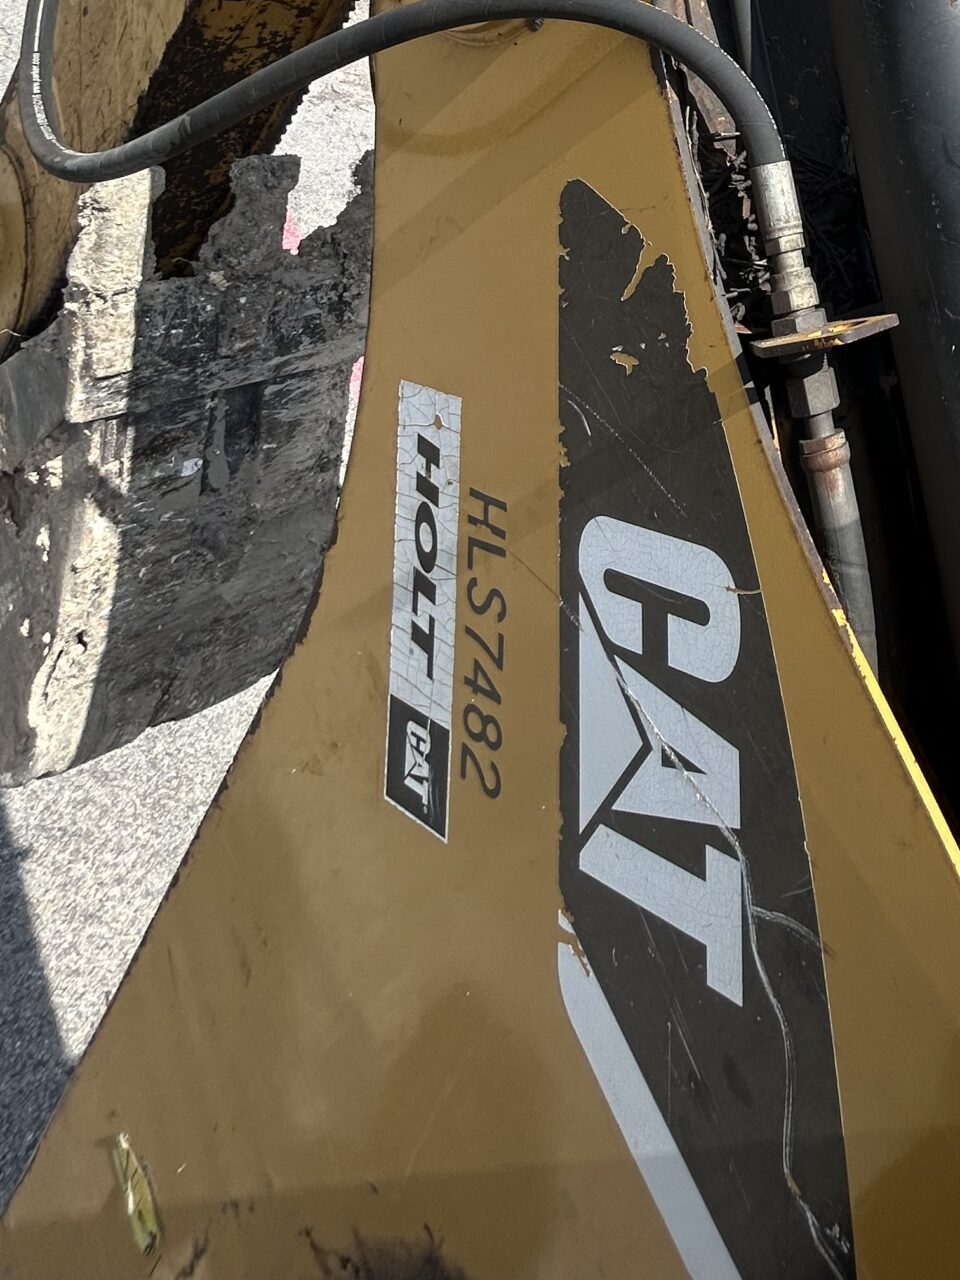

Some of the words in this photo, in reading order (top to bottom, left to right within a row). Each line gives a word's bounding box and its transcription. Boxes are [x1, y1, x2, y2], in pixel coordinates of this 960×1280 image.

[31, 52, 41, 94] www.parker.com
[410, 433, 440, 680] HOLT
[460, 486, 508, 800] HLS7482
[403, 720, 431, 804] CAT
[578, 515, 743, 1007] CAT
